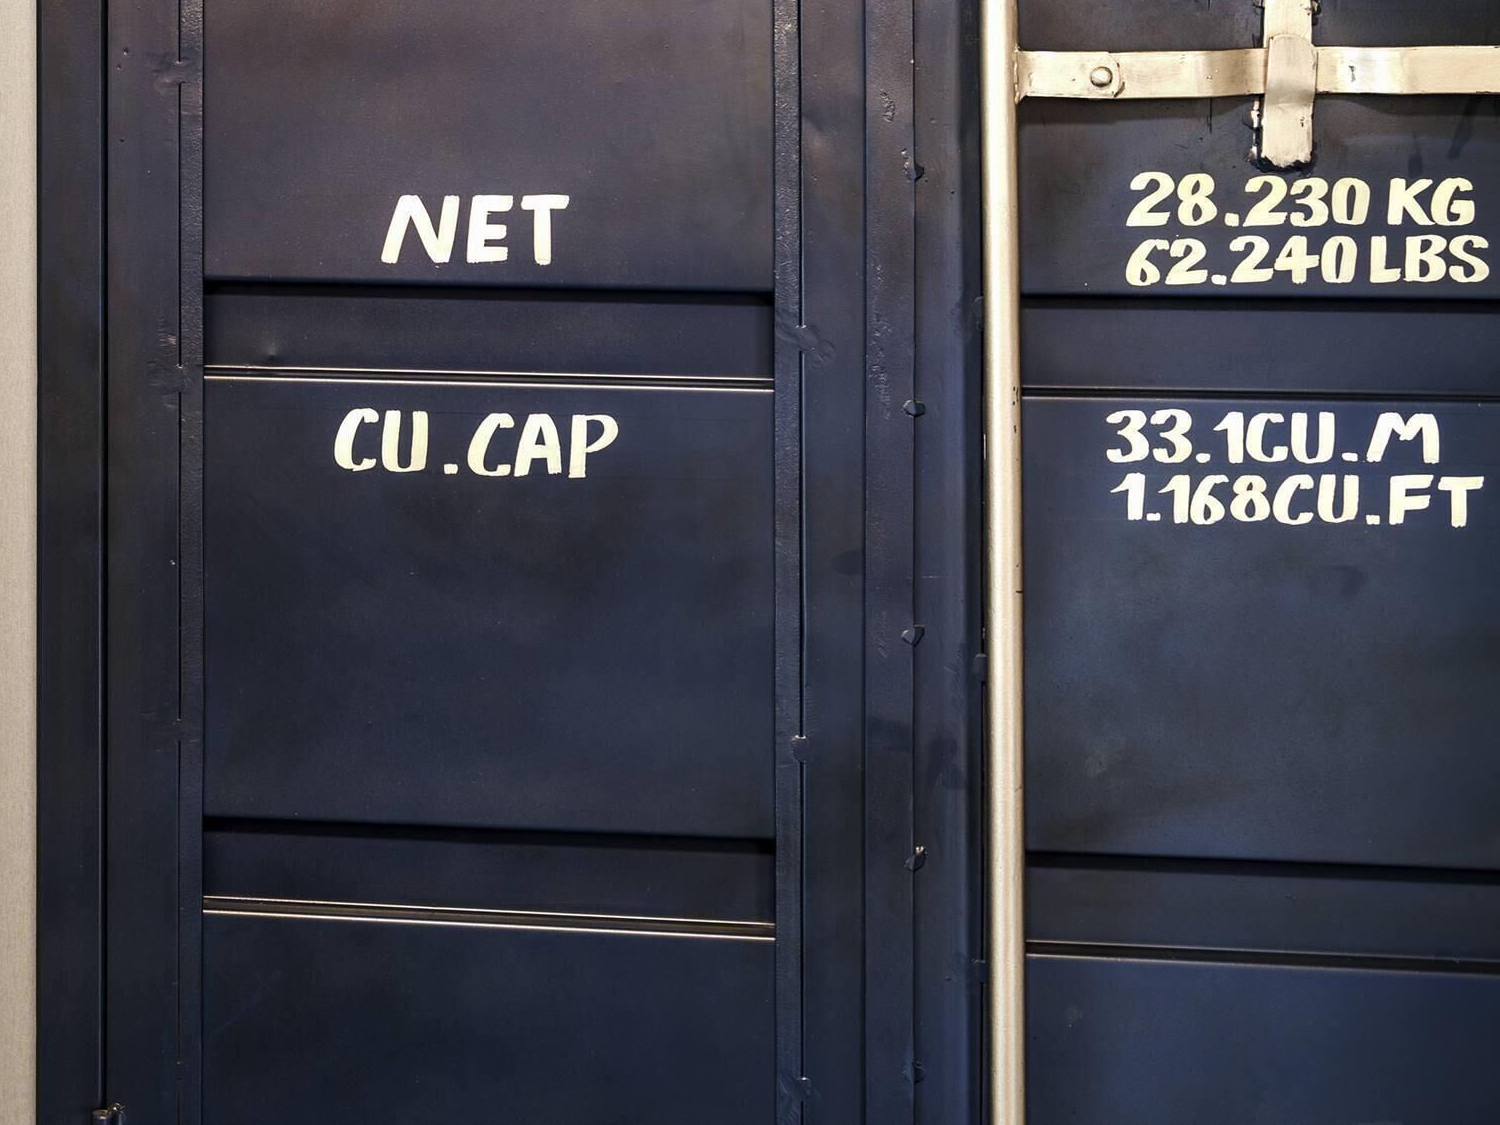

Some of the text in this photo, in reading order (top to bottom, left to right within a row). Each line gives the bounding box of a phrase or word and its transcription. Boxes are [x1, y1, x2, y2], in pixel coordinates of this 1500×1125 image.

[1125, 171, 1476, 228] 28.230 KG
[380, 194, 570, 266] NET
[1125, 234, 1490, 287] 62.240 LBS
